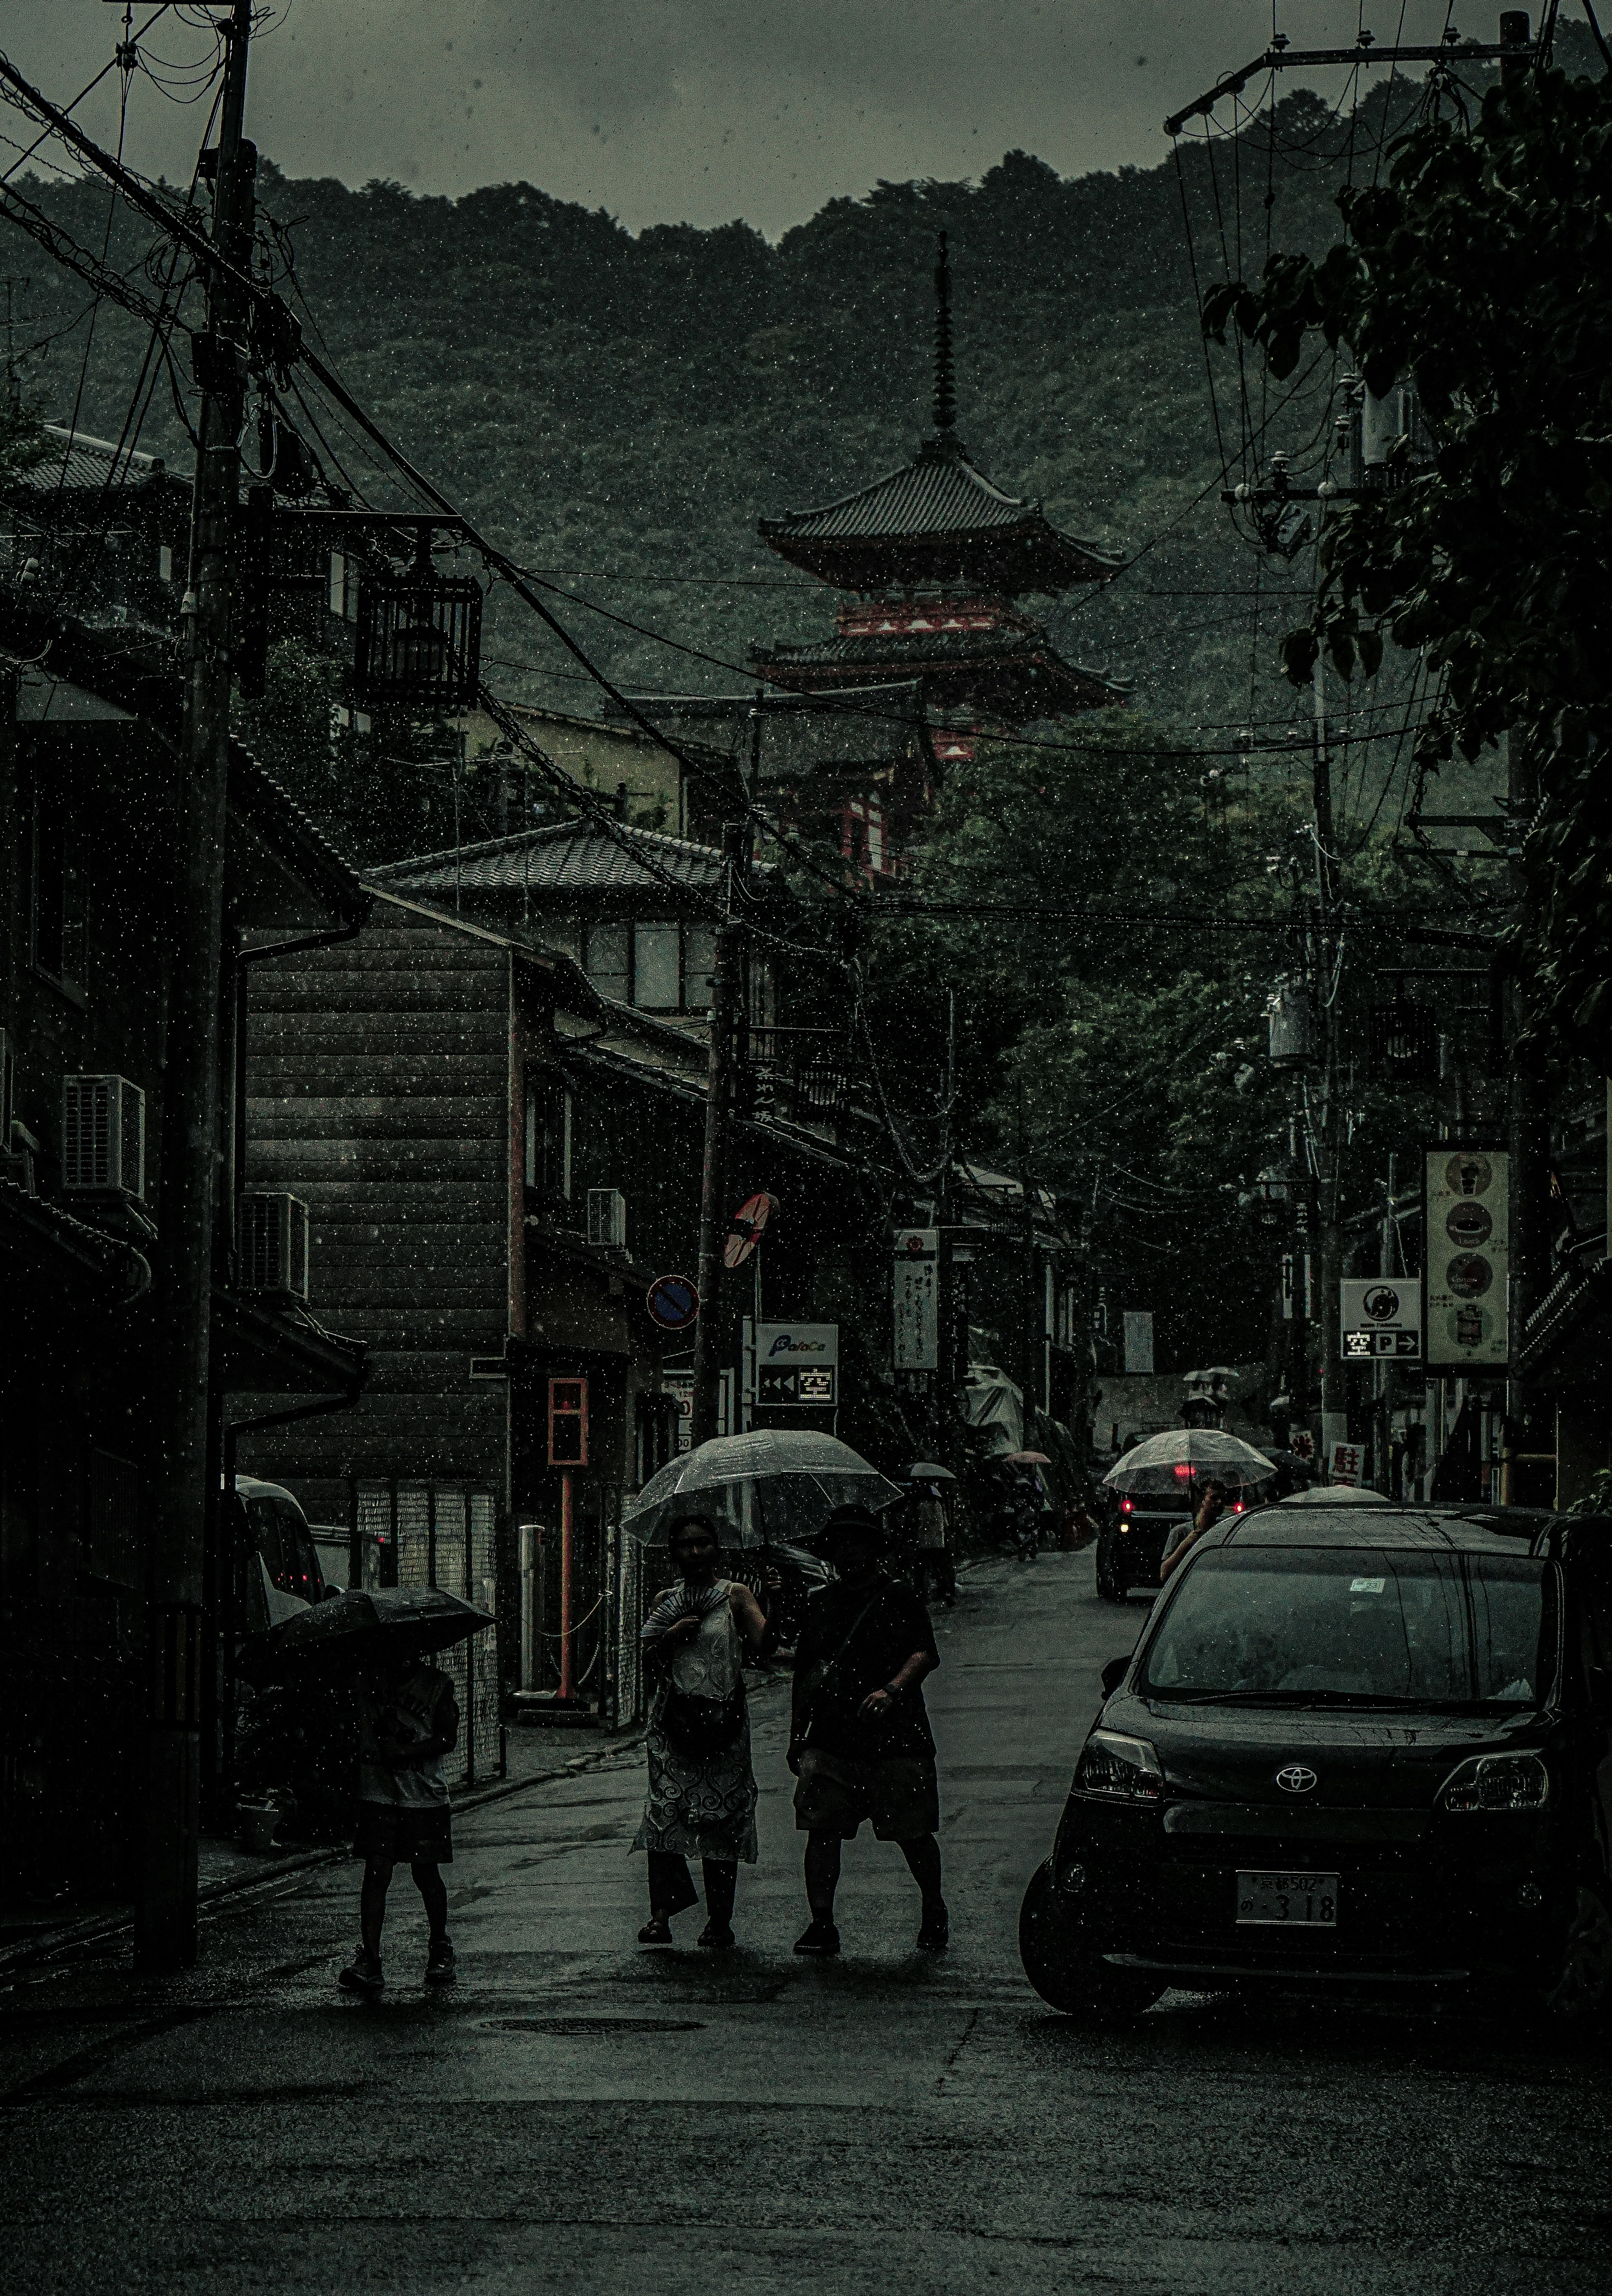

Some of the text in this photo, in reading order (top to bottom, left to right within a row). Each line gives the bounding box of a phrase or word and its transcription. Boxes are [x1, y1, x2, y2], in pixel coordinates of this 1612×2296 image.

[1347, 1332, 1370, 1356] 空
[1380, 1337, 1392, 1350] P
[800, 1367, 830, 1398] 空
[1261, 1877, 1316, 1891] 京都 502
[1241, 1901, 1253, 1912] の
